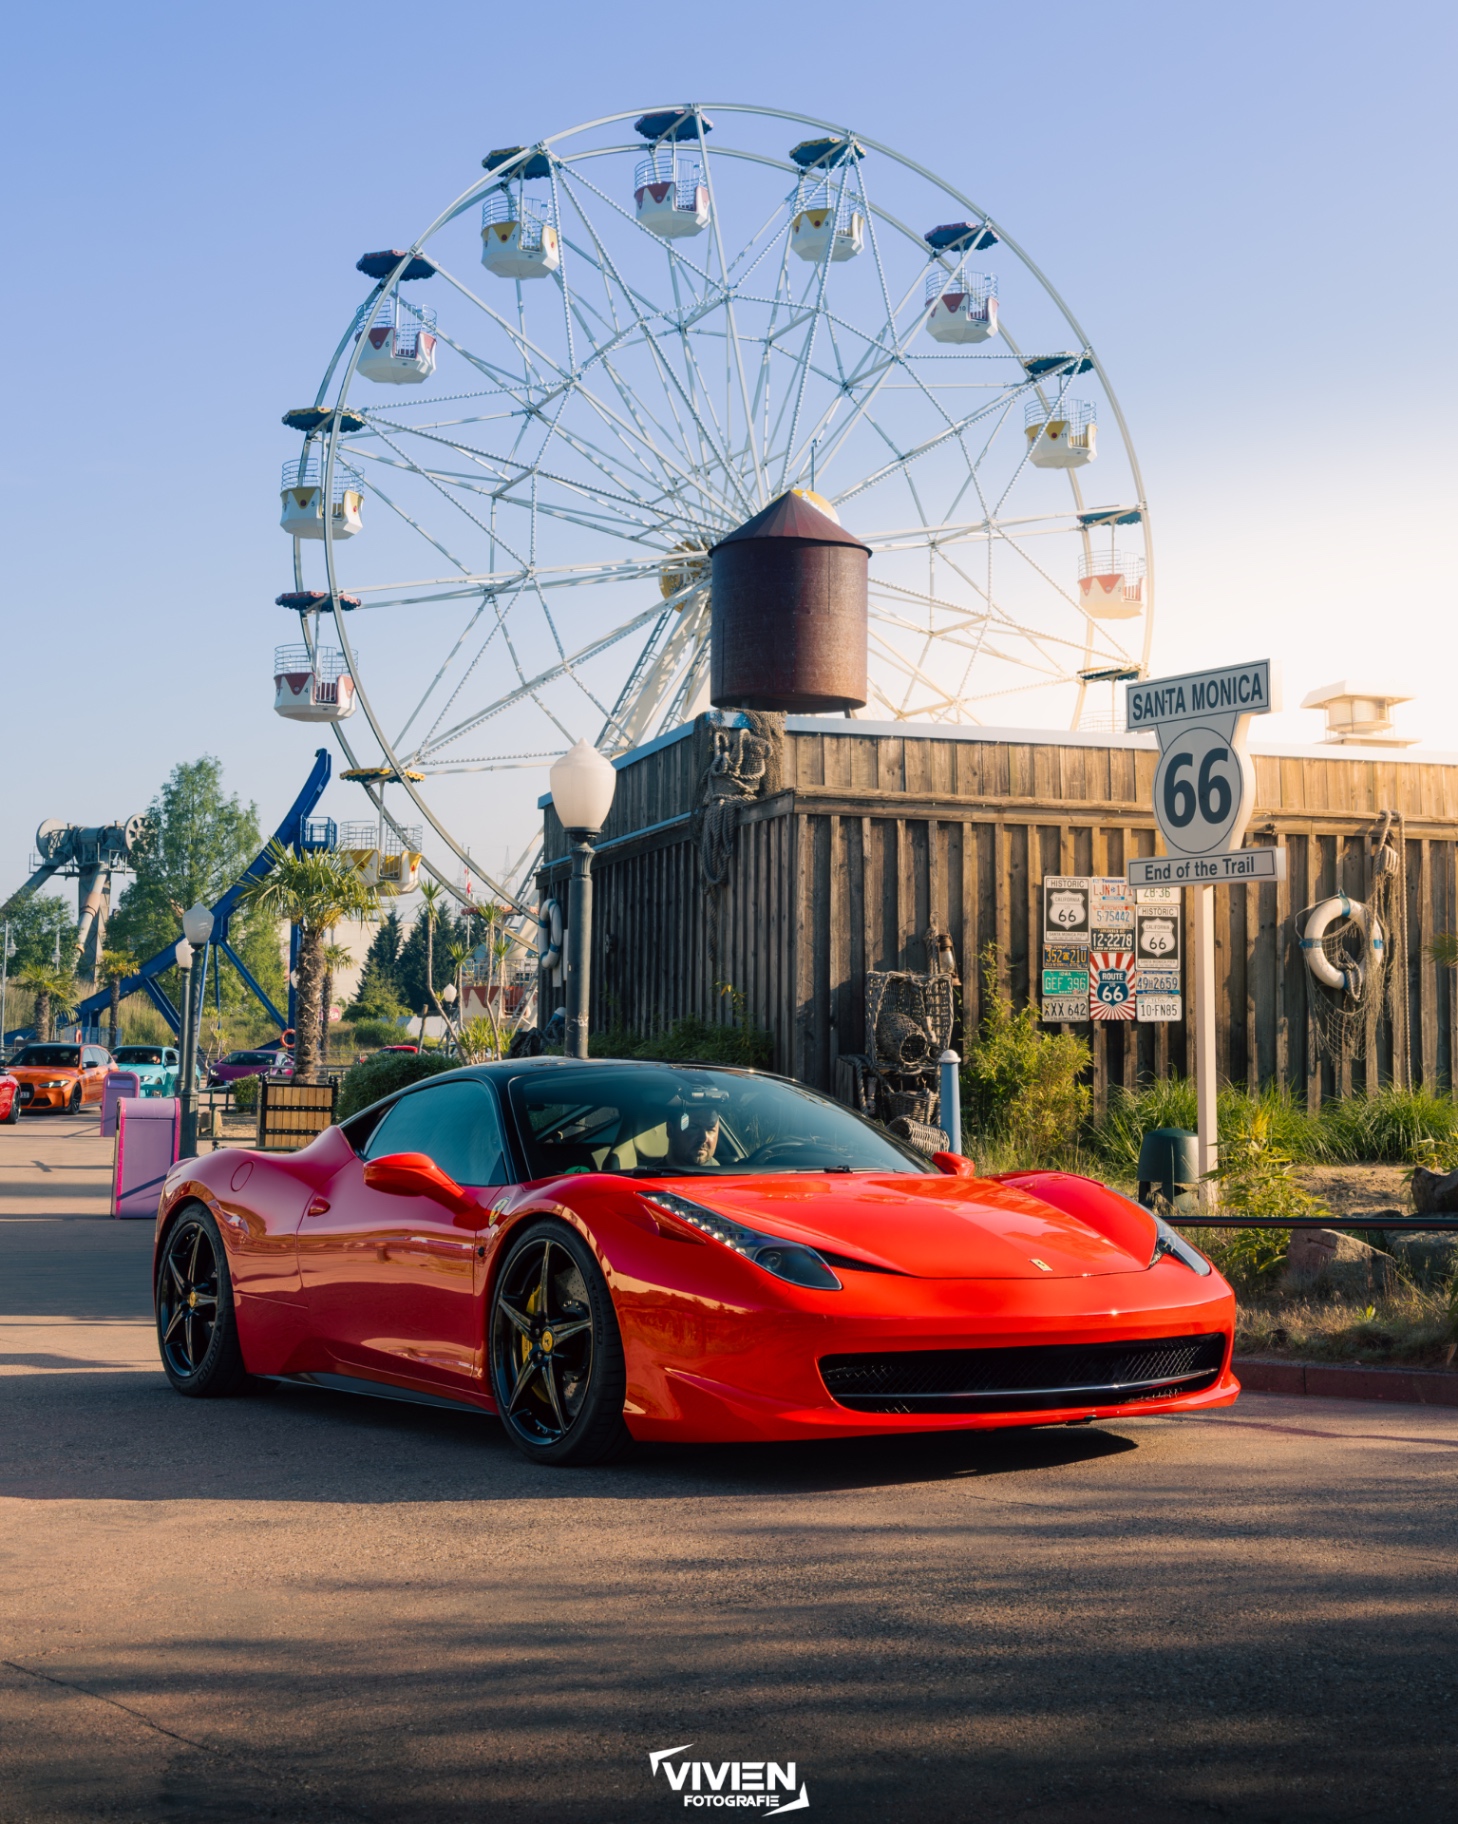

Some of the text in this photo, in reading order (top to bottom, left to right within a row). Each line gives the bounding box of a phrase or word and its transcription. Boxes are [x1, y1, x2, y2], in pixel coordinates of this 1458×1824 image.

[1132, 672, 1263, 721] SANTA MONICA
[1163, 747, 1232, 828] 66
[1145, 856, 1255, 881] End of the Trail
[1050, 880, 1084, 888] HISTORIC
[1093, 884, 1133, 896] LJN 171
[1058, 909, 1076, 922] 66
[1142, 908, 1174, 916] HISTORIC
[1149, 936, 1167, 950] 66
[1045, 949, 1063, 963] 352
[1102, 972, 1124, 980] ROUTE
[1045, 977, 1086, 990] GEF 396
[1102, 986, 1124, 1002] 66
[1044, 1002, 1087, 1016] XXX 642
